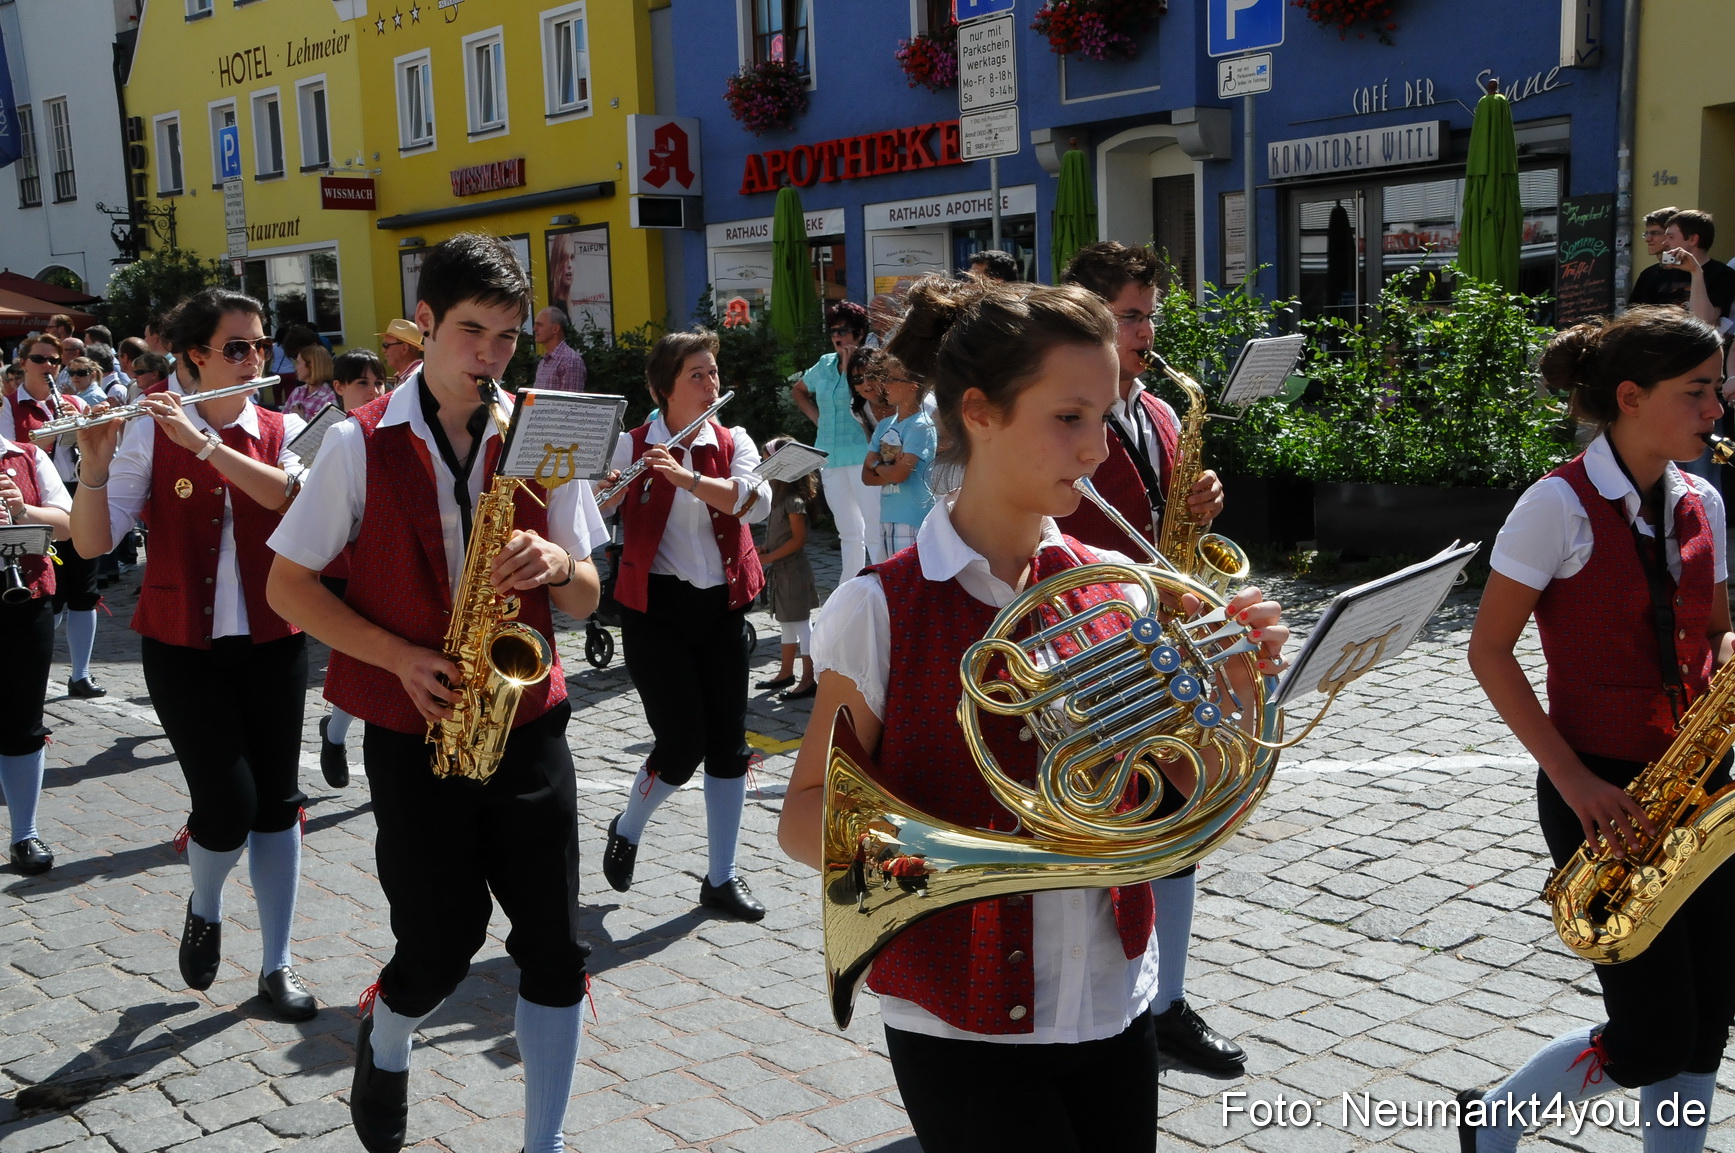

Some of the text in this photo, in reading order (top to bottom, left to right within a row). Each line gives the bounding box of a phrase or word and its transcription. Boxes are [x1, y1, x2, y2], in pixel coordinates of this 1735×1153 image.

[969, 25, 1002, 42] nur mit
[963, 38, 1010, 57] Parkschein
[218, 29, 350, 88] HOTEL Lehmeier
[967, 54, 1007, 71] werktags
[962, 75, 985, 89] Mo-Fr
[1352, 65, 1561, 115] CAFÉ DER Snne
[963, 93, 973, 103] Sa
[223, 134, 235, 172] P
[739, 119, 963, 195] APOTHEKE
[1272, 127, 1434, 175] KONDITOREI WITTL
[450, 158, 520, 197] WISSMACH
[324, 187, 373, 200] WISSMACH
[889, 203, 941, 222] RATHAUS
[246, 215, 300, 243] staurant
[726, 224, 768, 240] RATHAUS
[579, 243, 604, 253] TAIFUN
